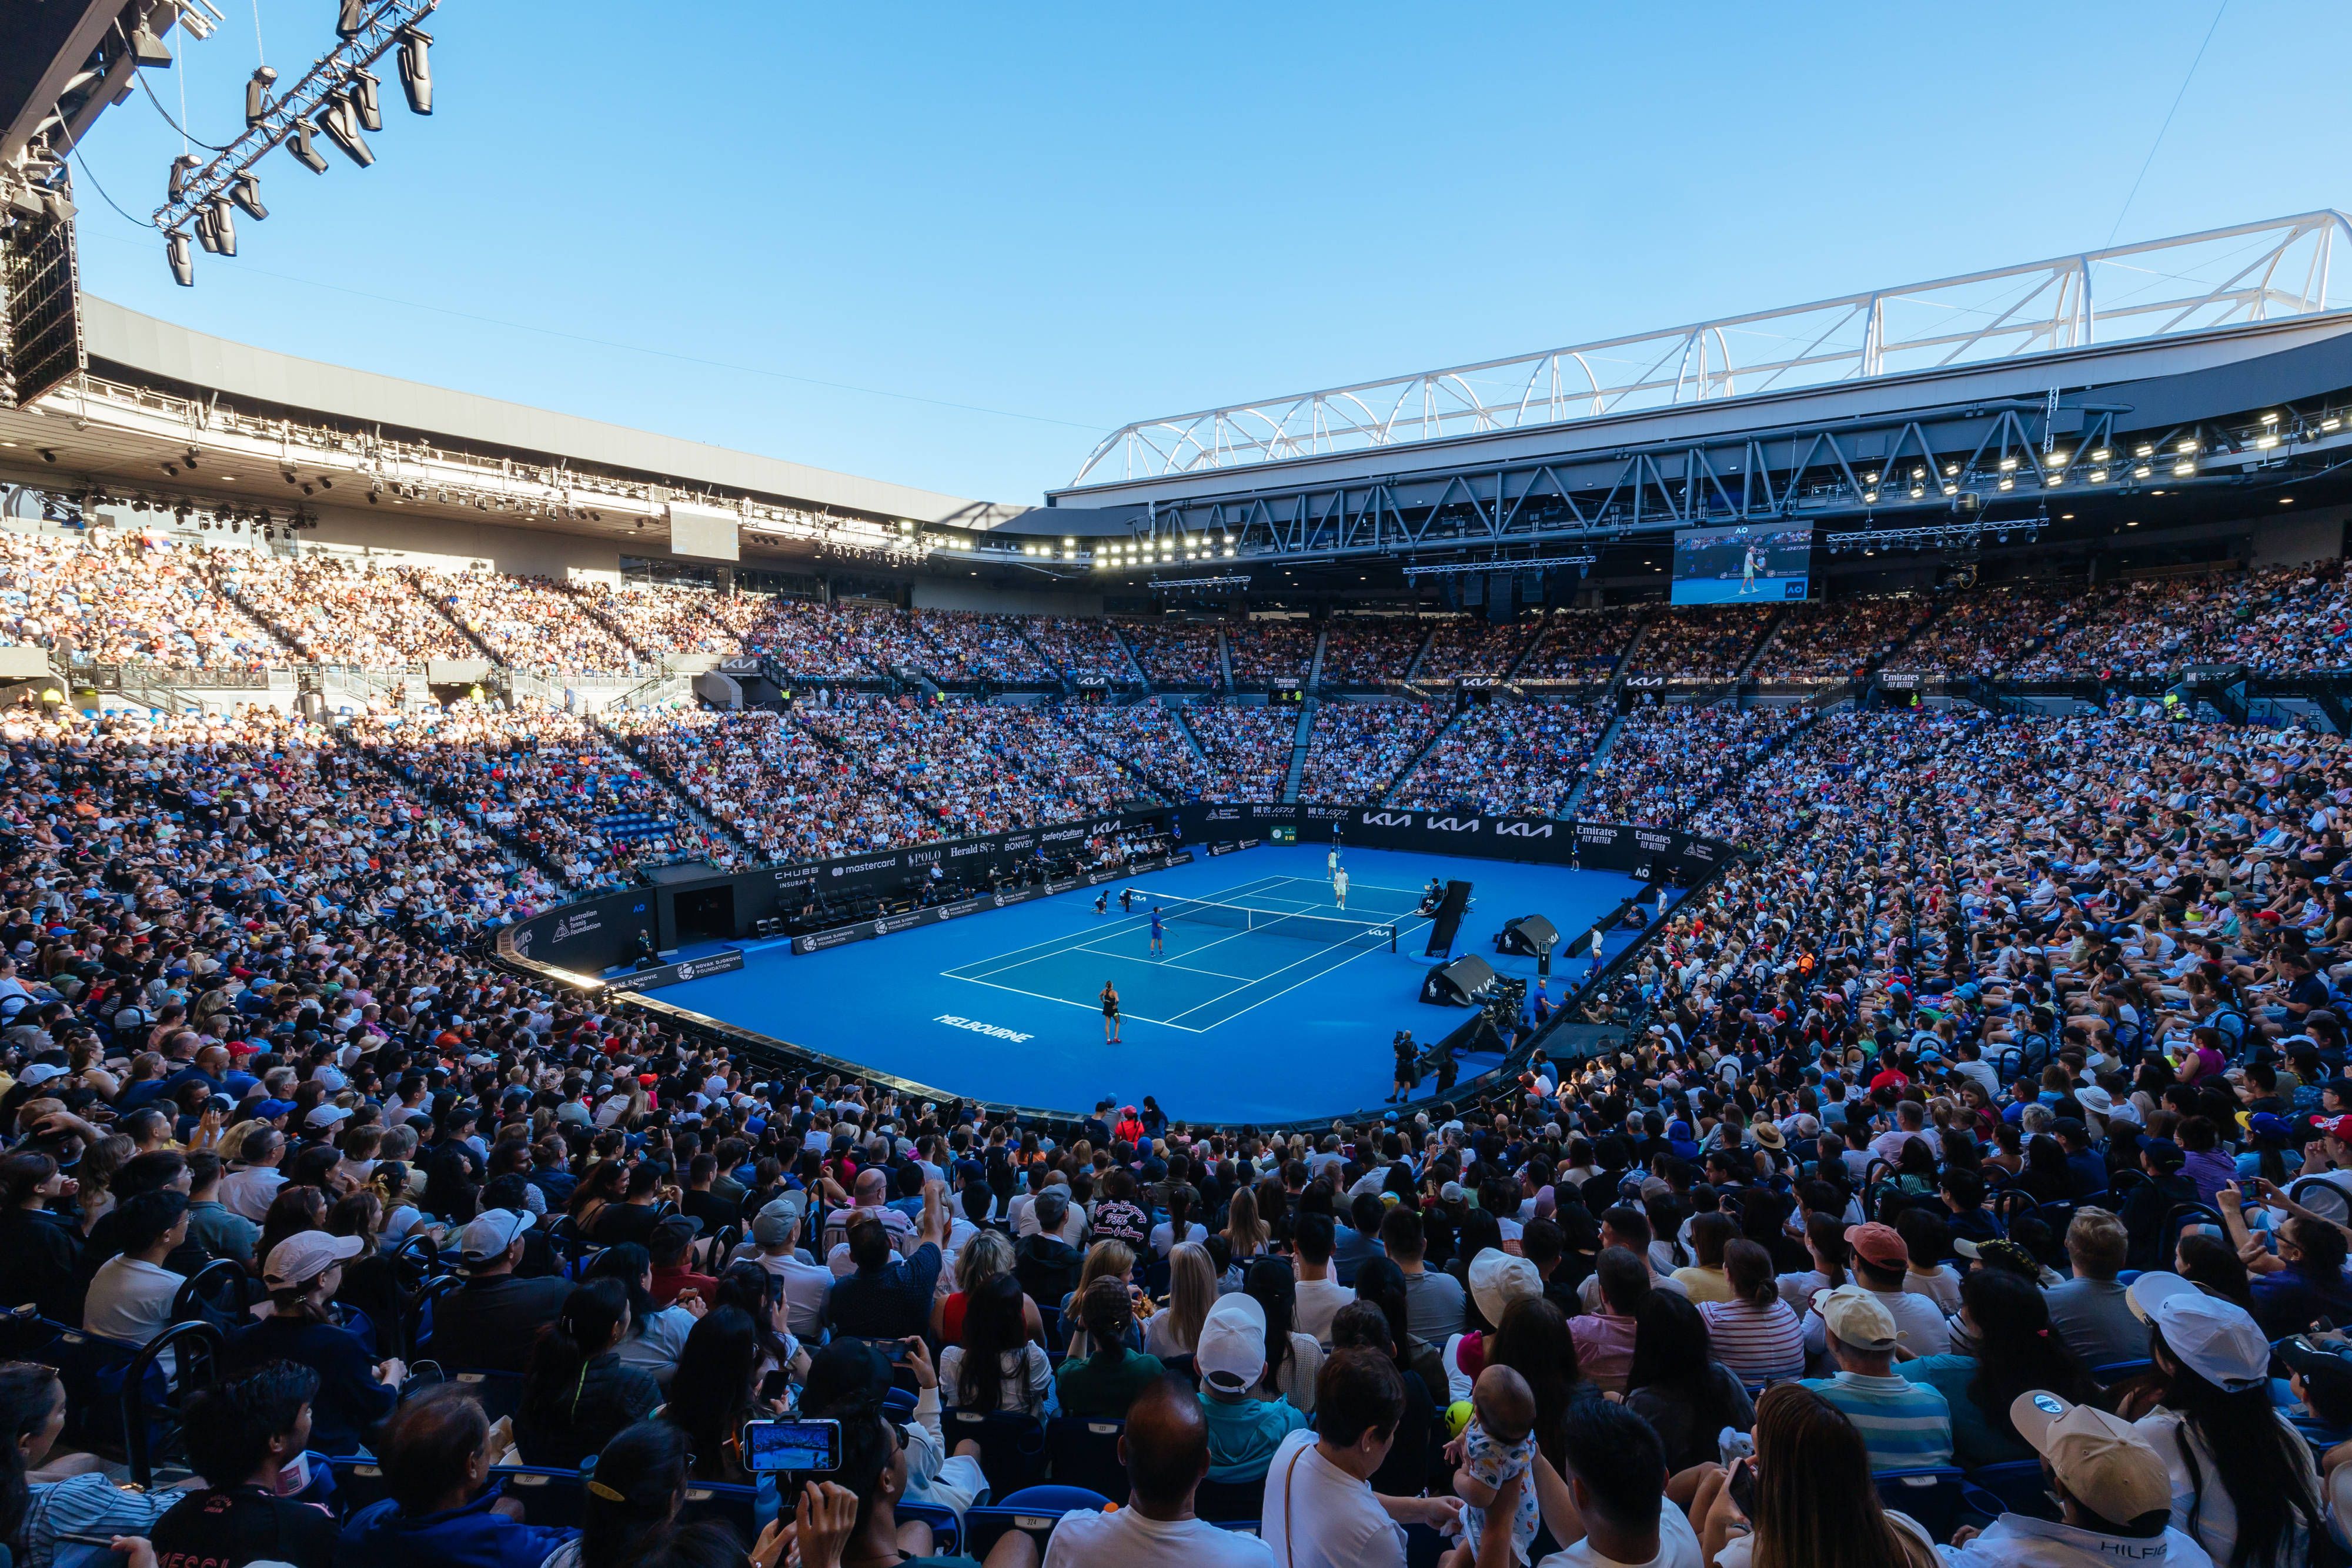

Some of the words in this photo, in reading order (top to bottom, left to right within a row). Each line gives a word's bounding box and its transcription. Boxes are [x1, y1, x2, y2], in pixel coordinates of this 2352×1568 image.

[721, 658, 757, 669] KIA
[1077, 677, 1104, 685] KIA
[1463, 678, 1492, 686] KIA
[1626, 677, 1662, 686] KIA
[1883, 673, 1919, 681] Emirates
[1363, 812, 1411, 827] KIA
[1427, 817, 1479, 833] KIA
[1093, 820, 1120, 835] KIA
[1496, 821, 1552, 838] KIA
[1576, 825, 1618, 837] Emirates
[1042, 828, 1084, 842] SafetyCulture
[1592, 836, 1611, 845] BETTER
[1635, 830, 1671, 845] Emirates
[951, 844, 978, 858] Herald
[1005, 840, 1034, 852] BONVOY
[1649, 842, 1665, 852] BETTER
[915, 850, 941, 864] POLO
[846, 857, 896, 875] mastercard
[775, 867, 818, 880] CHUBB
[1635, 867, 1649, 878] AO
[779, 877, 816, 889] INSURANE
[633, 903, 645, 913] AO
[569, 910, 597, 923] Australian
[901, 915, 921, 923] DJOKOVIC
[570, 920, 587, 930] Tennis
[570, 922, 601, 936] Foundation
[888, 921, 913, 930] FOUNDATION
[833, 930, 854, 940] DJOKOVIC
[818, 937, 846, 947] FOUNDATION
[695, 961, 714, 969] NOVAK
[716, 955, 741, 966] DJOKOVIC
[696, 963, 731, 974] FOUNDATION
[628, 974, 658, 985] DJOKOVIC
[932, 1014, 1035, 1043] MELBOURNE
[1120, 1200, 1147, 1223] Company
[1120, 1225, 1144, 1242] Always
